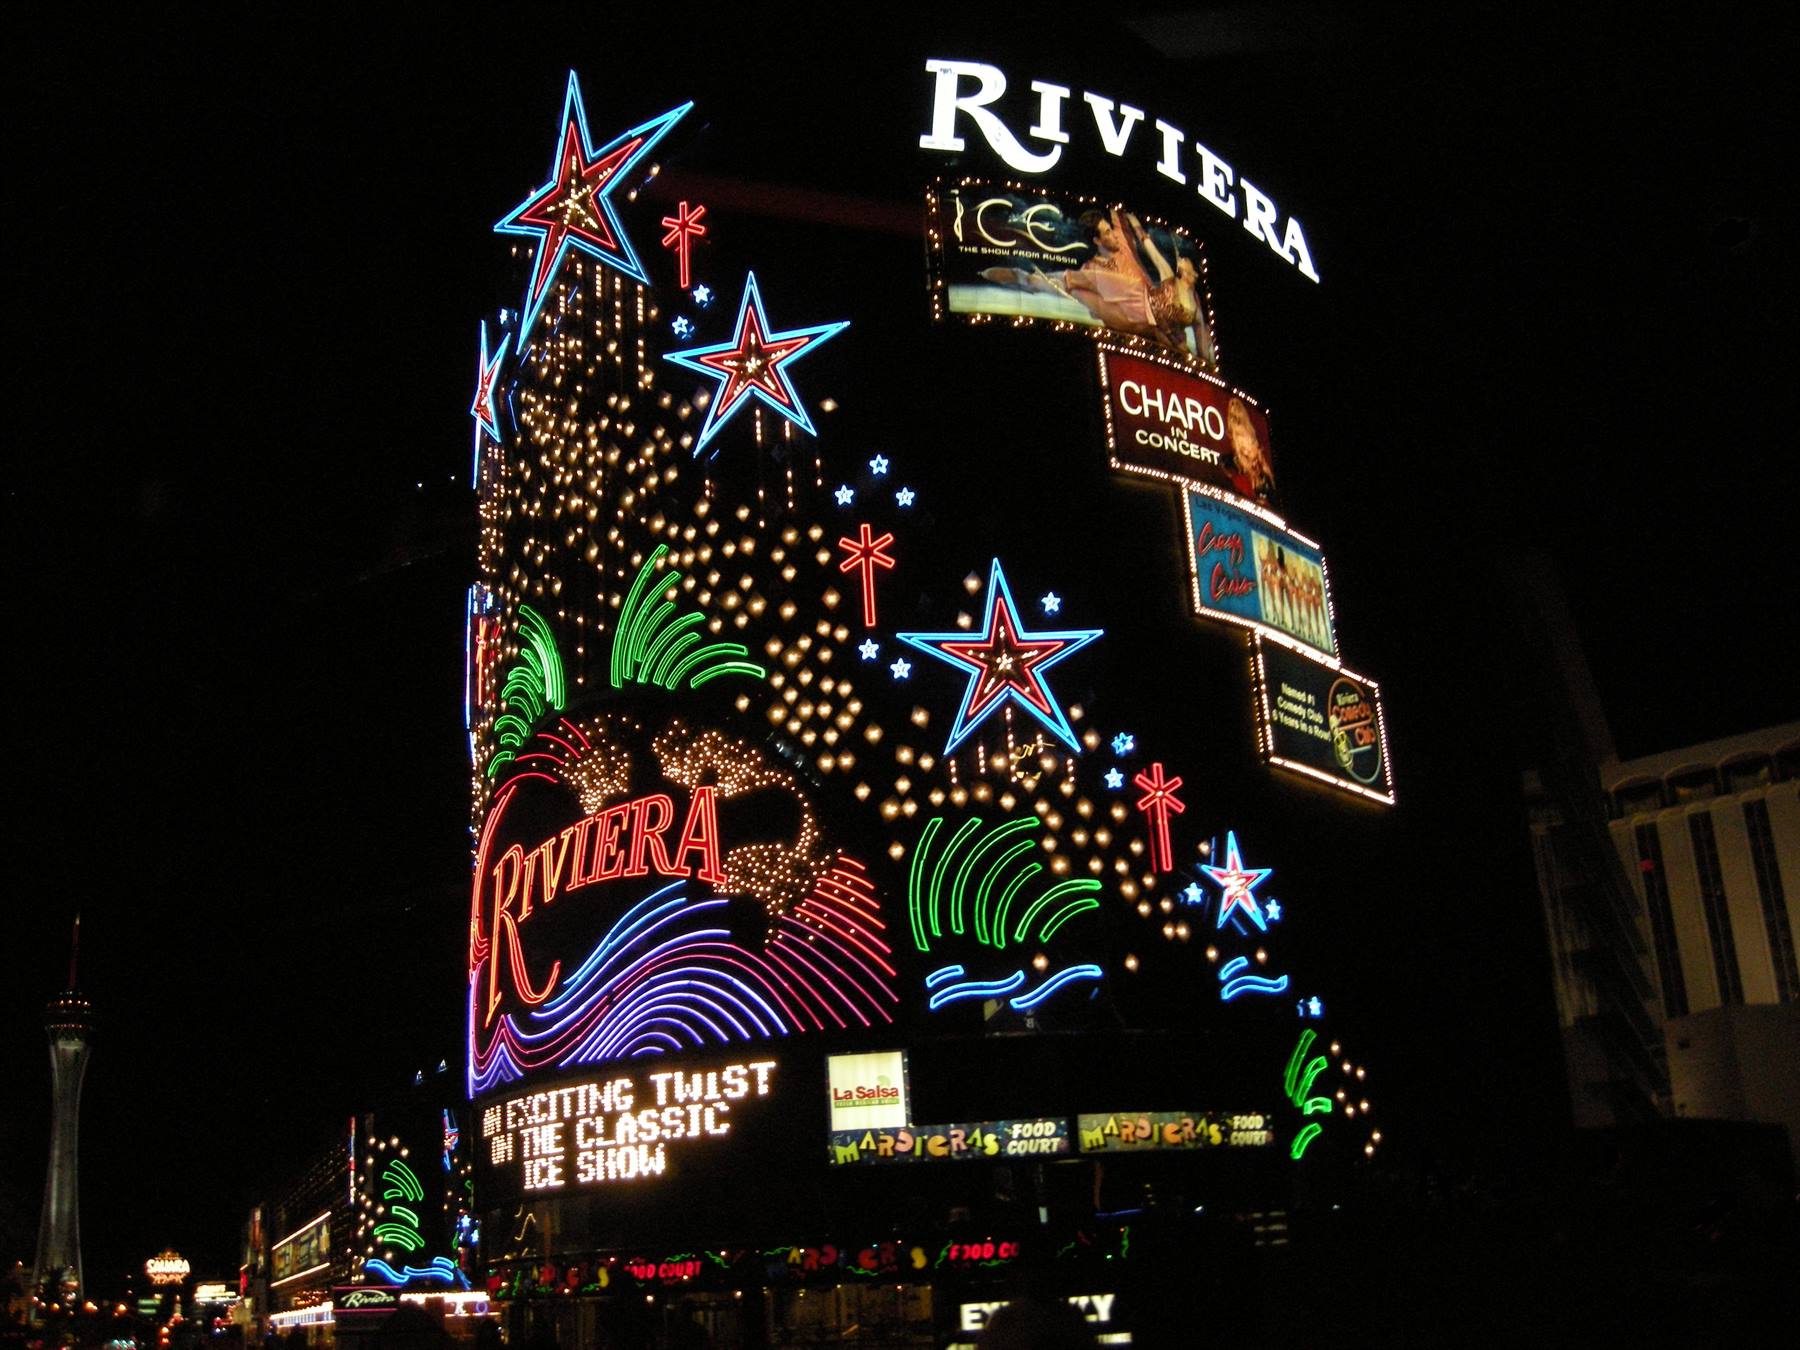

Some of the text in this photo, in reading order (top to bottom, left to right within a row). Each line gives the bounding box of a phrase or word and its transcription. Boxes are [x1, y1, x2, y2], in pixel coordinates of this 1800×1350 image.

[919, 58, 1320, 283] RIVIERA
[958, 246, 1078, 265] THE SHOW FROM RUSSIA
[1119, 380, 1225, 441] CHARO
[1170, 425, 1188, 441] IN
[1135, 429, 1221, 466] CONCERT
[1277, 696, 1324, 724] Comedy Club
[485, 785, 729, 1029] RIVIERA
[506, 1078, 635, 1129] EXCITING
[649, 1061, 777, 1106] TWIST
[833, 1085, 899, 1101] La Salsa
[519, 1122, 565, 1158] THE
[575, 1101, 731, 1149] CLASSIC
[1012, 1121, 1057, 1138] FOOD
[1232, 1115, 1264, 1129] FOOD
[1006, 1137, 1061, 1155] COURT
[1230, 1128, 1268, 1146] COURT
[523, 1142, 666, 1190] ICE SHOW
[341, 1289, 396, 1308] Riviera
